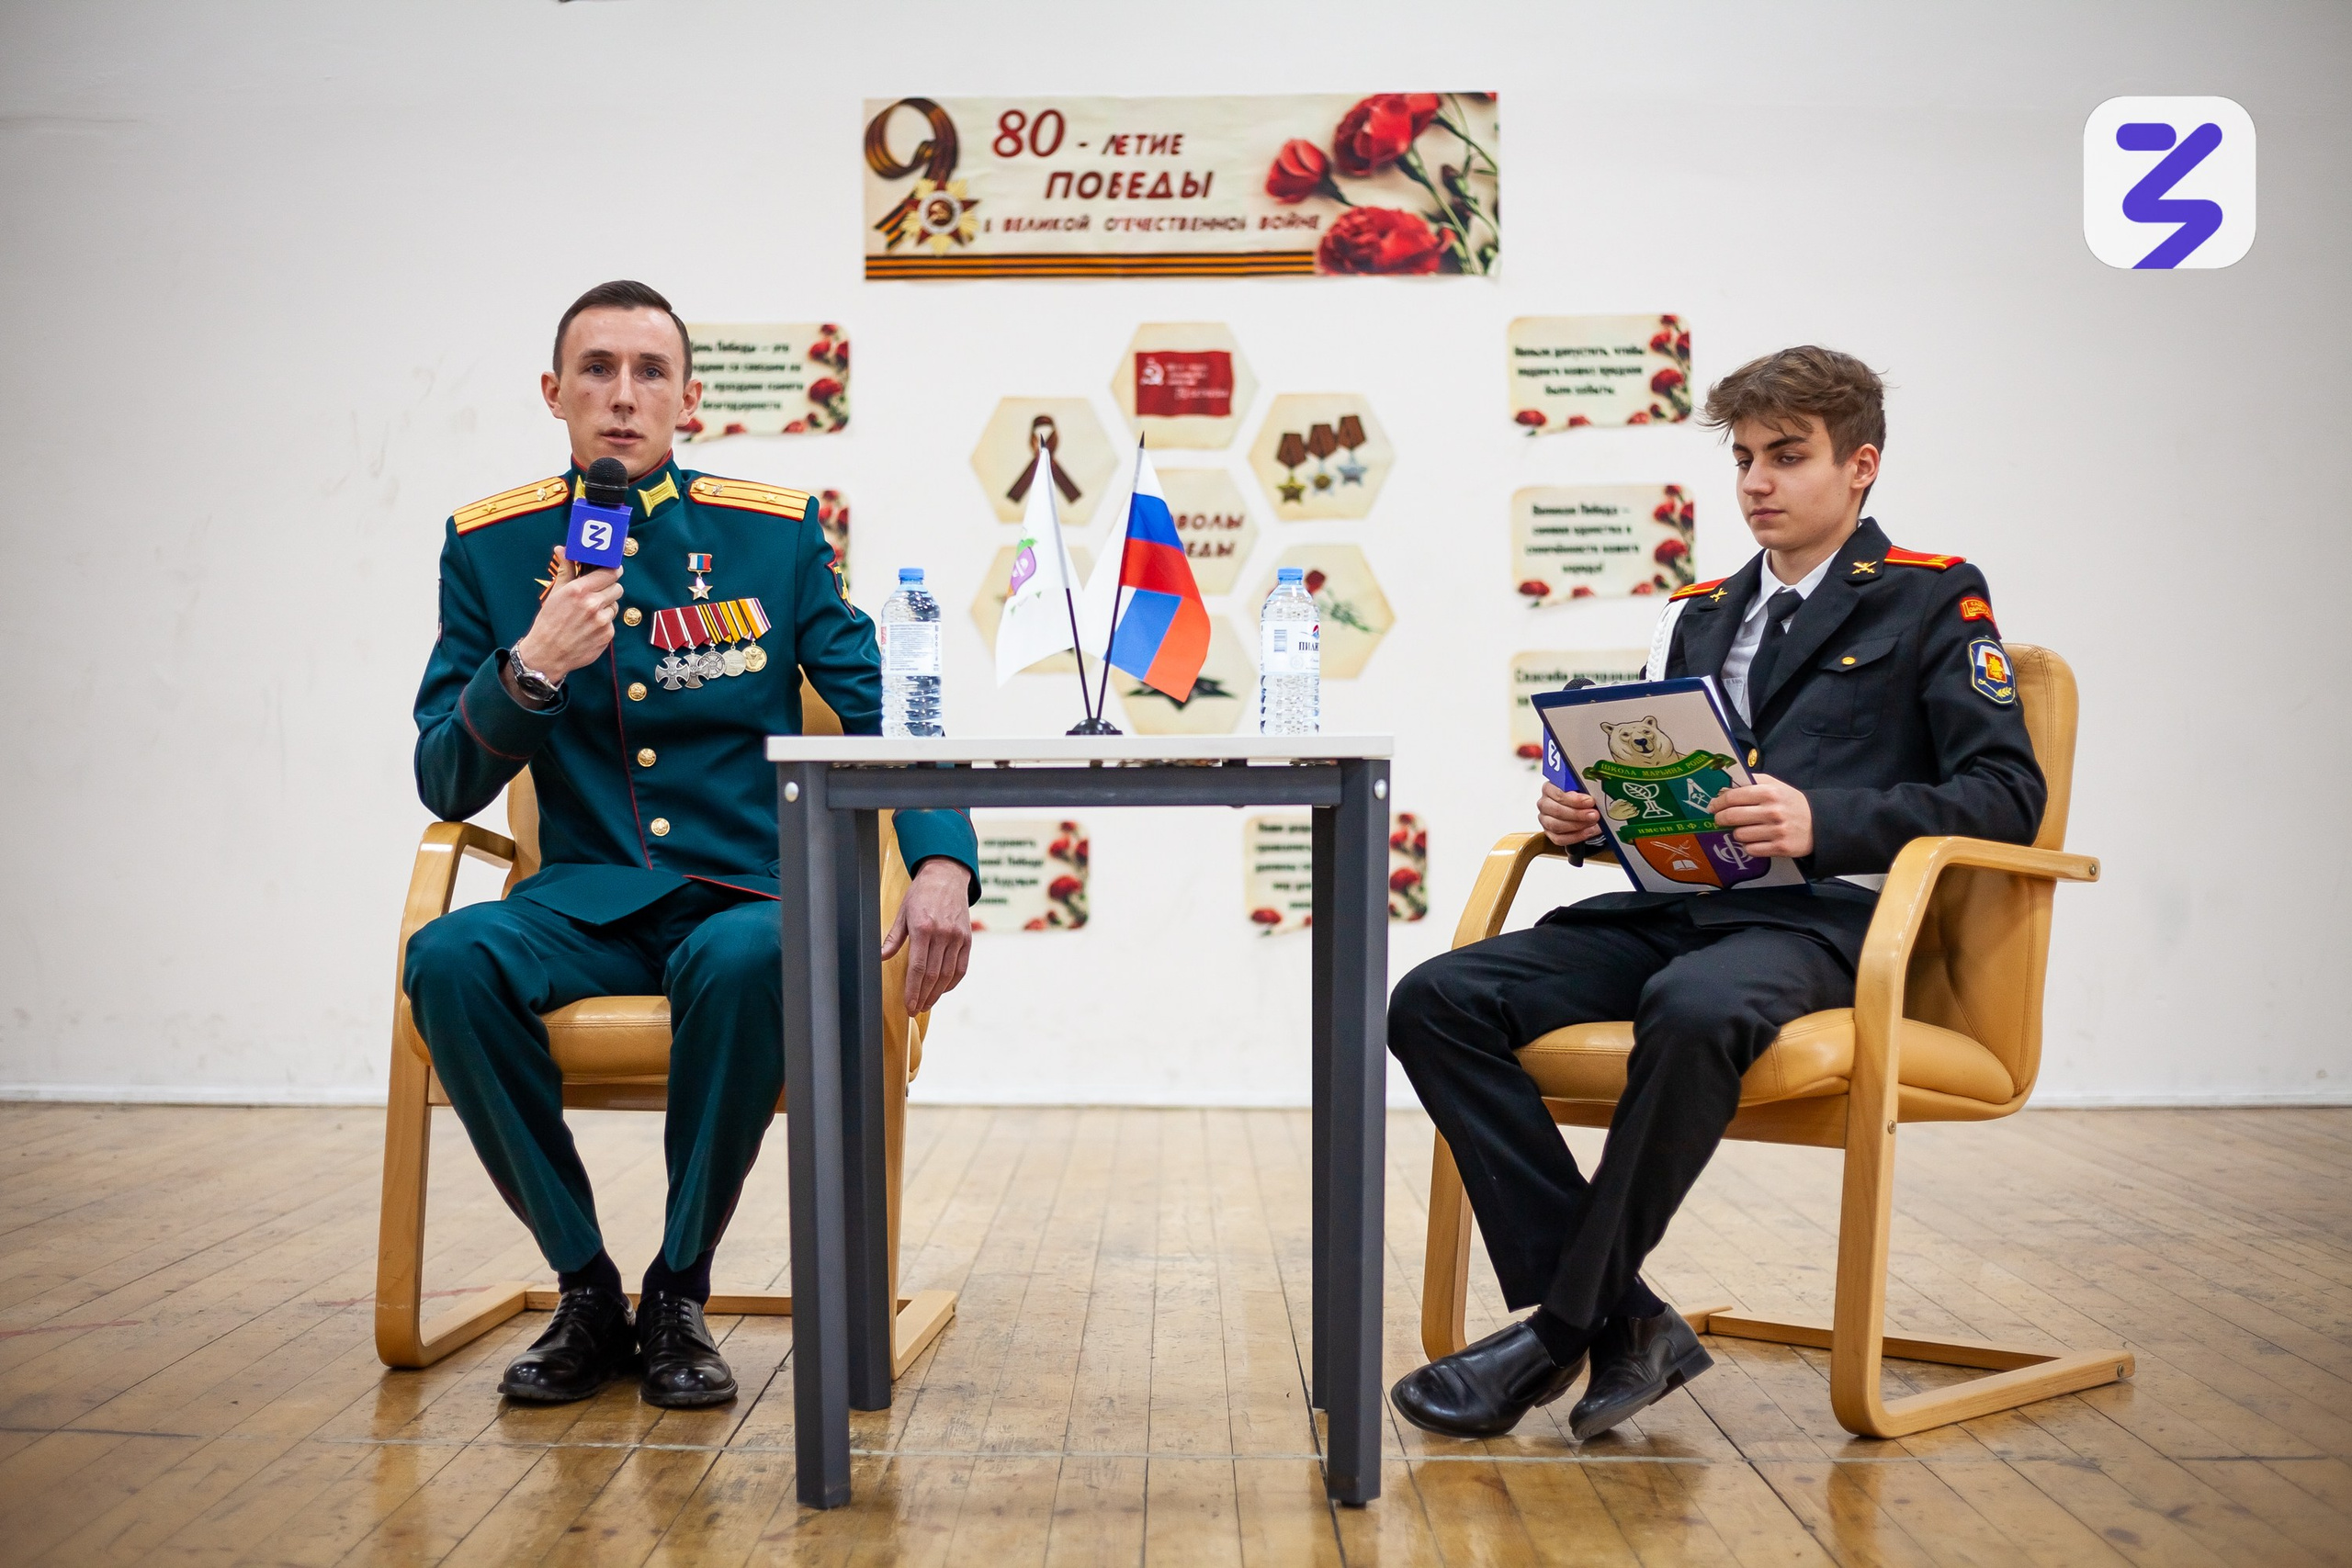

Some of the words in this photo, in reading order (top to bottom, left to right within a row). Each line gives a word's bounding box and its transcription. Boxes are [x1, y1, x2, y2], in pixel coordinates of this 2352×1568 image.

[992, 108, 1066, 158] 80
[1102, 133, 1184, 156] ЛЕТИЕ
[1045, 170, 1213, 199] ПОБЕДЫ
[1003, 214, 1091, 231] ВЕЛИКОЙ
[1259, 212, 1320, 231] ВОЙНЕ
[1172, 513, 1244, 530] ВОЛЫ
[1185, 540, 1235, 558] ЕДЫ
[1600, 763, 1637, 776] ШКОЛА
[1642, 766, 1684, 777] МАРЬИНА
[1685, 753, 1709, 769] РОЩА
[1638, 826, 1674, 834] имени
